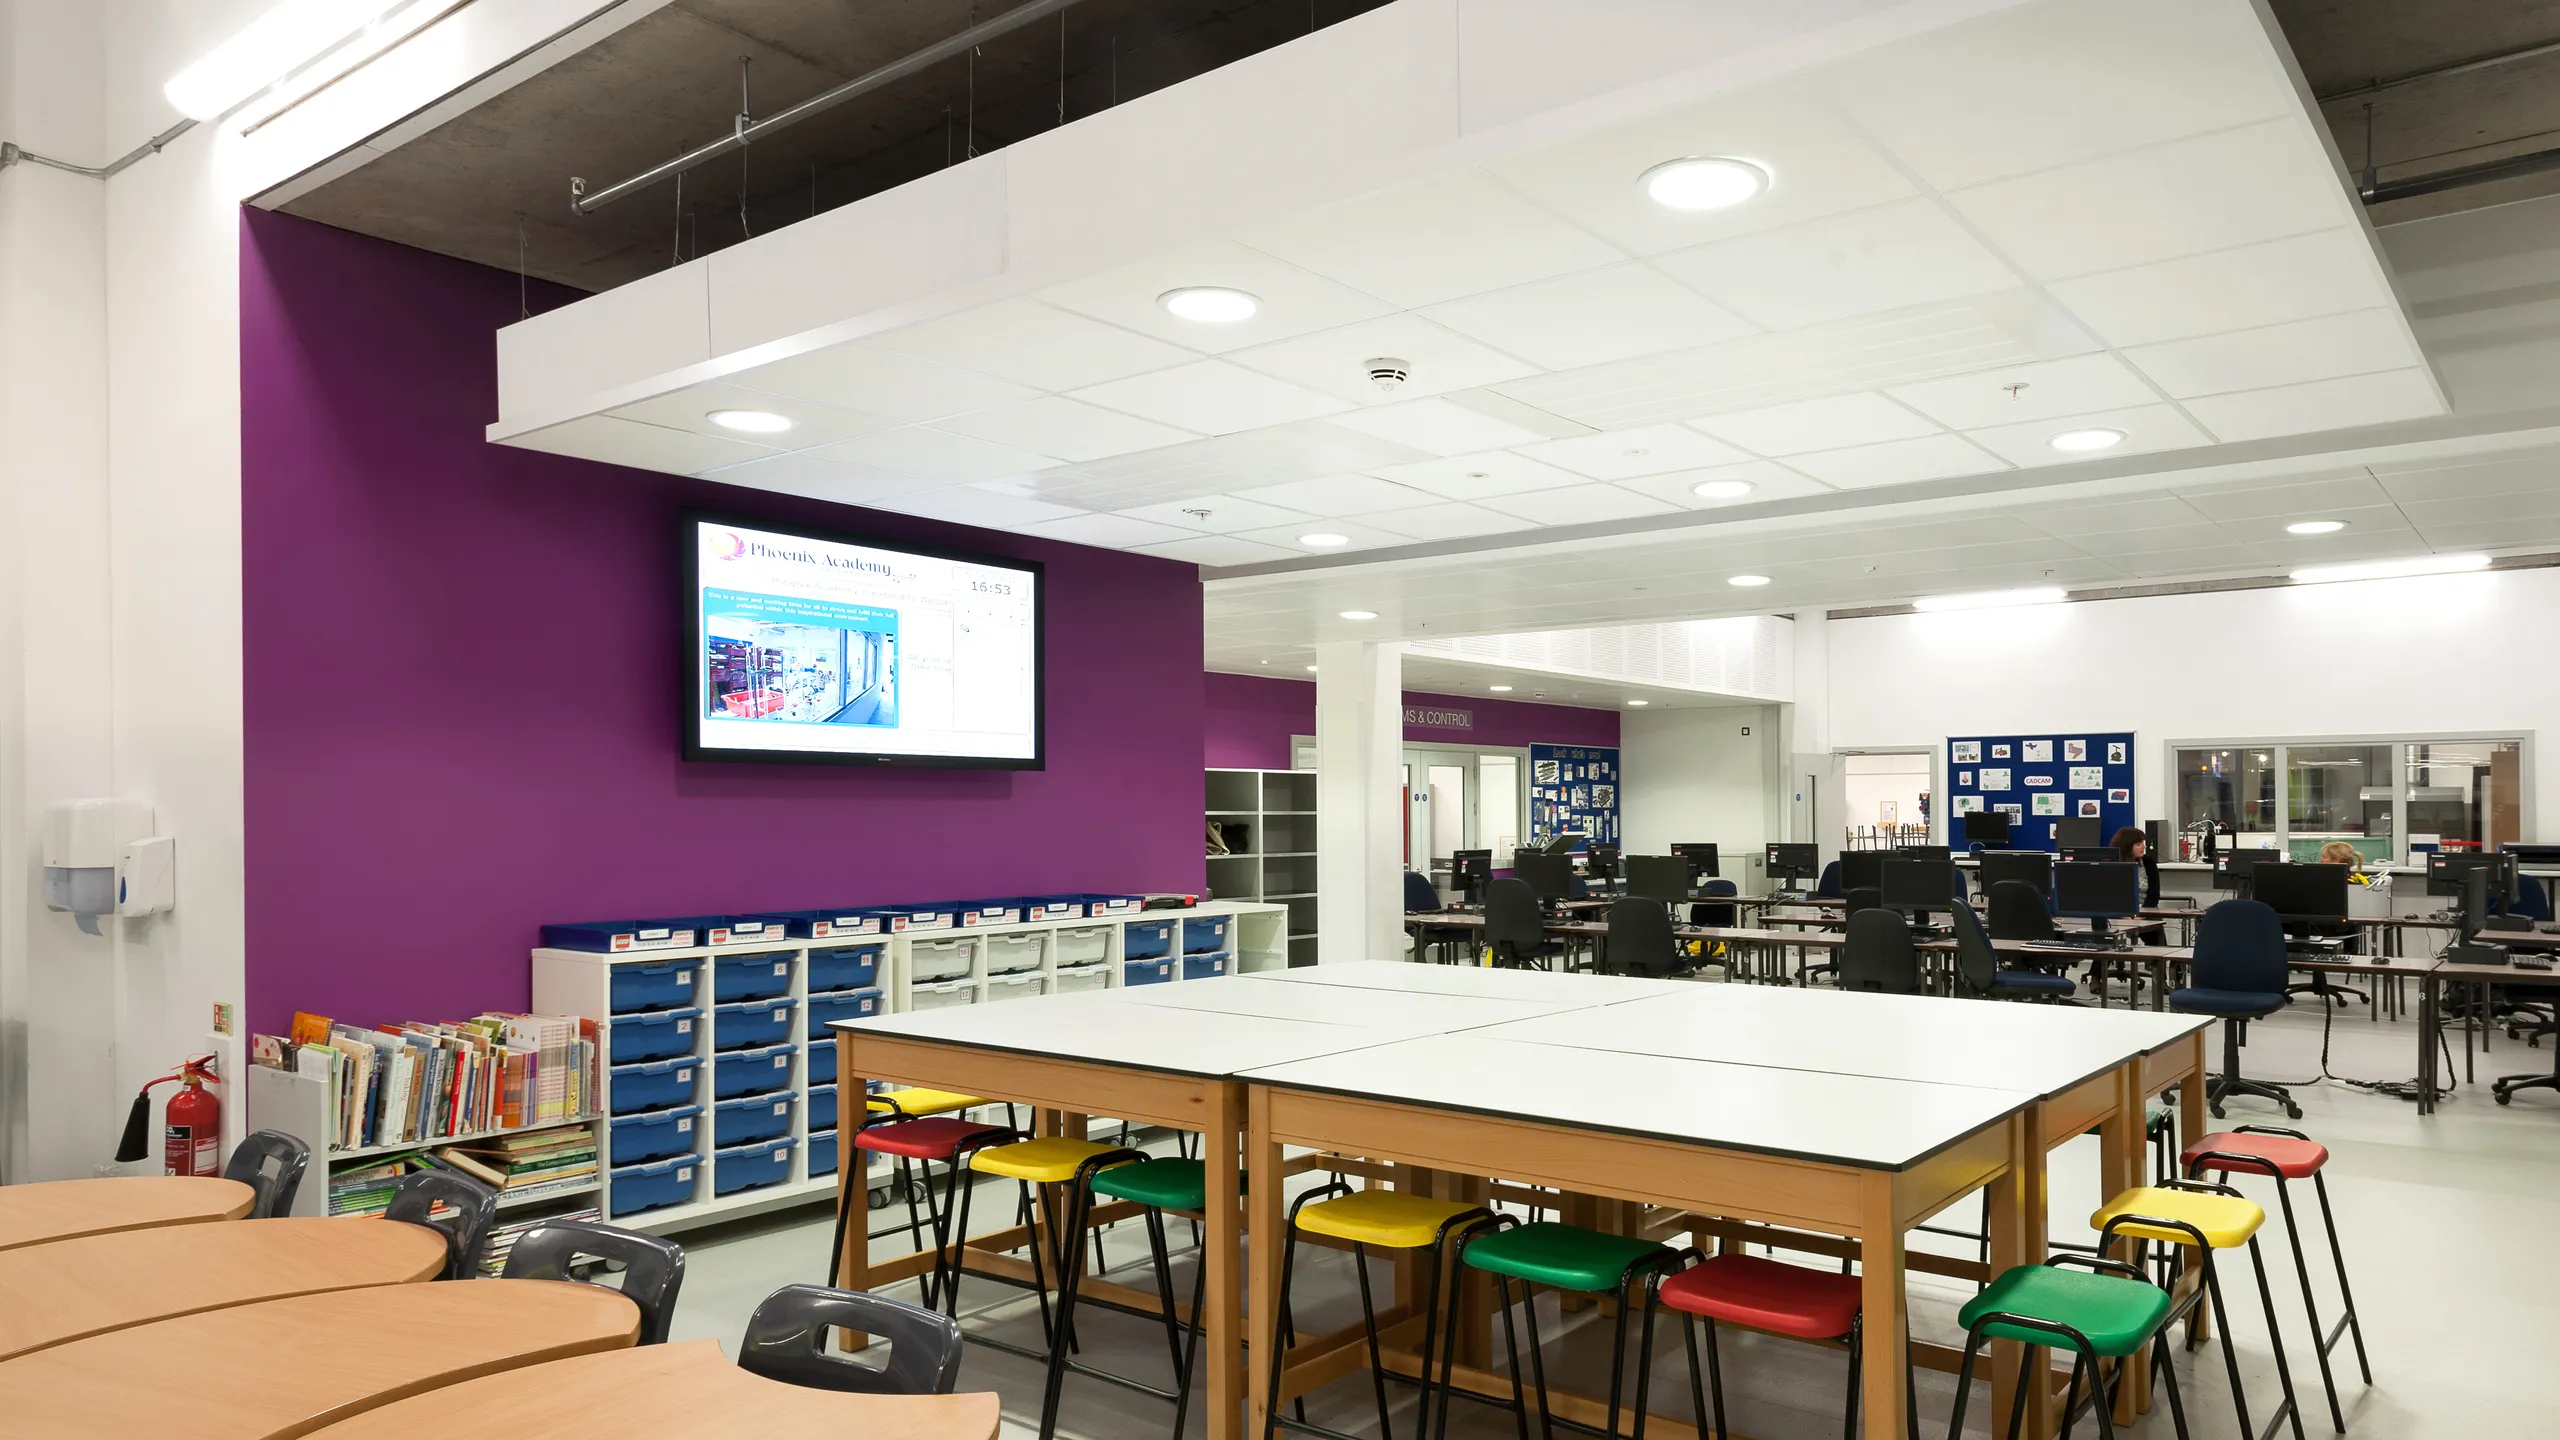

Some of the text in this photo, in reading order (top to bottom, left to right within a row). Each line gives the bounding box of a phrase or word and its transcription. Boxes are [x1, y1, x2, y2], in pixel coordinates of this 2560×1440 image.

[751, 542, 816, 564] Phoenix
[823, 554, 892, 577] Academy
[972, 581, 1011, 596] 16:53
[708, 591, 721, 599] This
[736, 603, 764, 611] potential
[1418, 711, 1425, 724] &
[1427, 711, 1470, 727] CONTROL
[862, 1001, 871, 1009] 12
[681, 1022, 688, 1030] 2
[777, 1058, 783, 1066] 8
[681, 1072, 687, 1080] 4
[777, 1105, 783, 1113] 9
[681, 1121, 688, 1129] 3
[776, 1151, 785, 1159] 10
